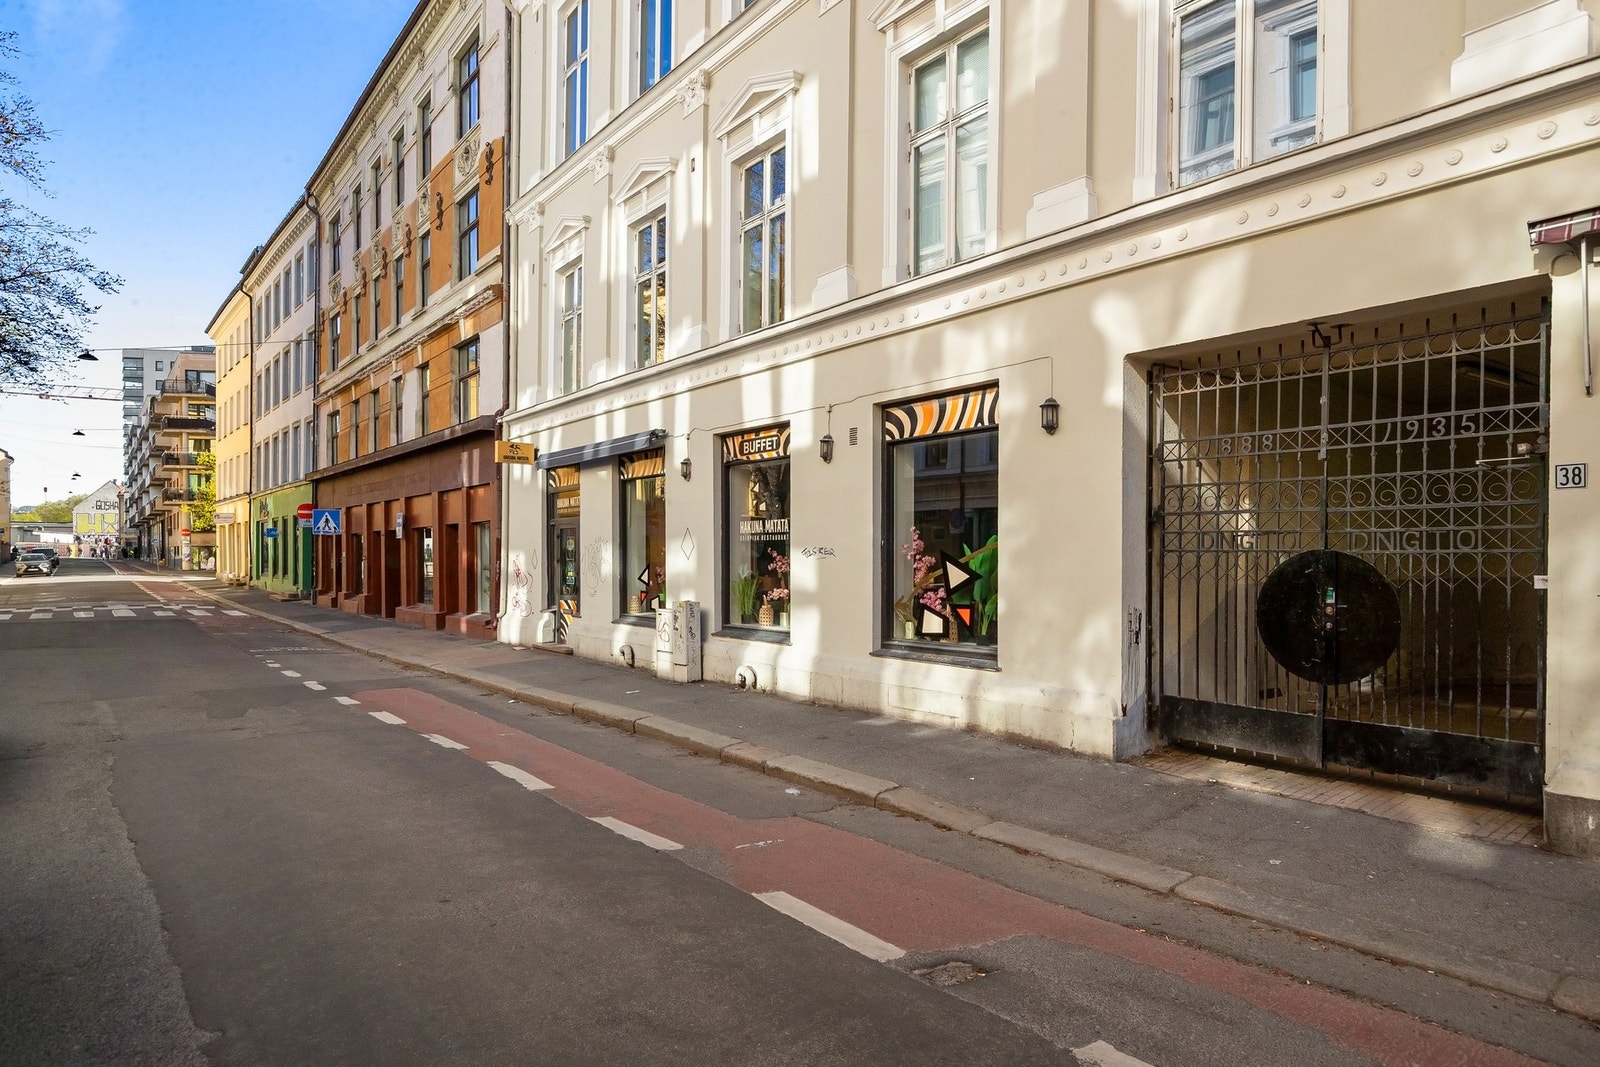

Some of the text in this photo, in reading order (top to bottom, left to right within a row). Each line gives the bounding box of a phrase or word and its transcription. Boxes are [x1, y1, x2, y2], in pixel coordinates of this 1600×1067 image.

[1382, 414, 1475, 443] 1935
[743, 437, 778, 454] BUFFET
[1559, 466, 1582, 486] 38
[96, 500, 119, 510] GOSHA
[740, 519, 789, 533] HAKUNA MATATA
